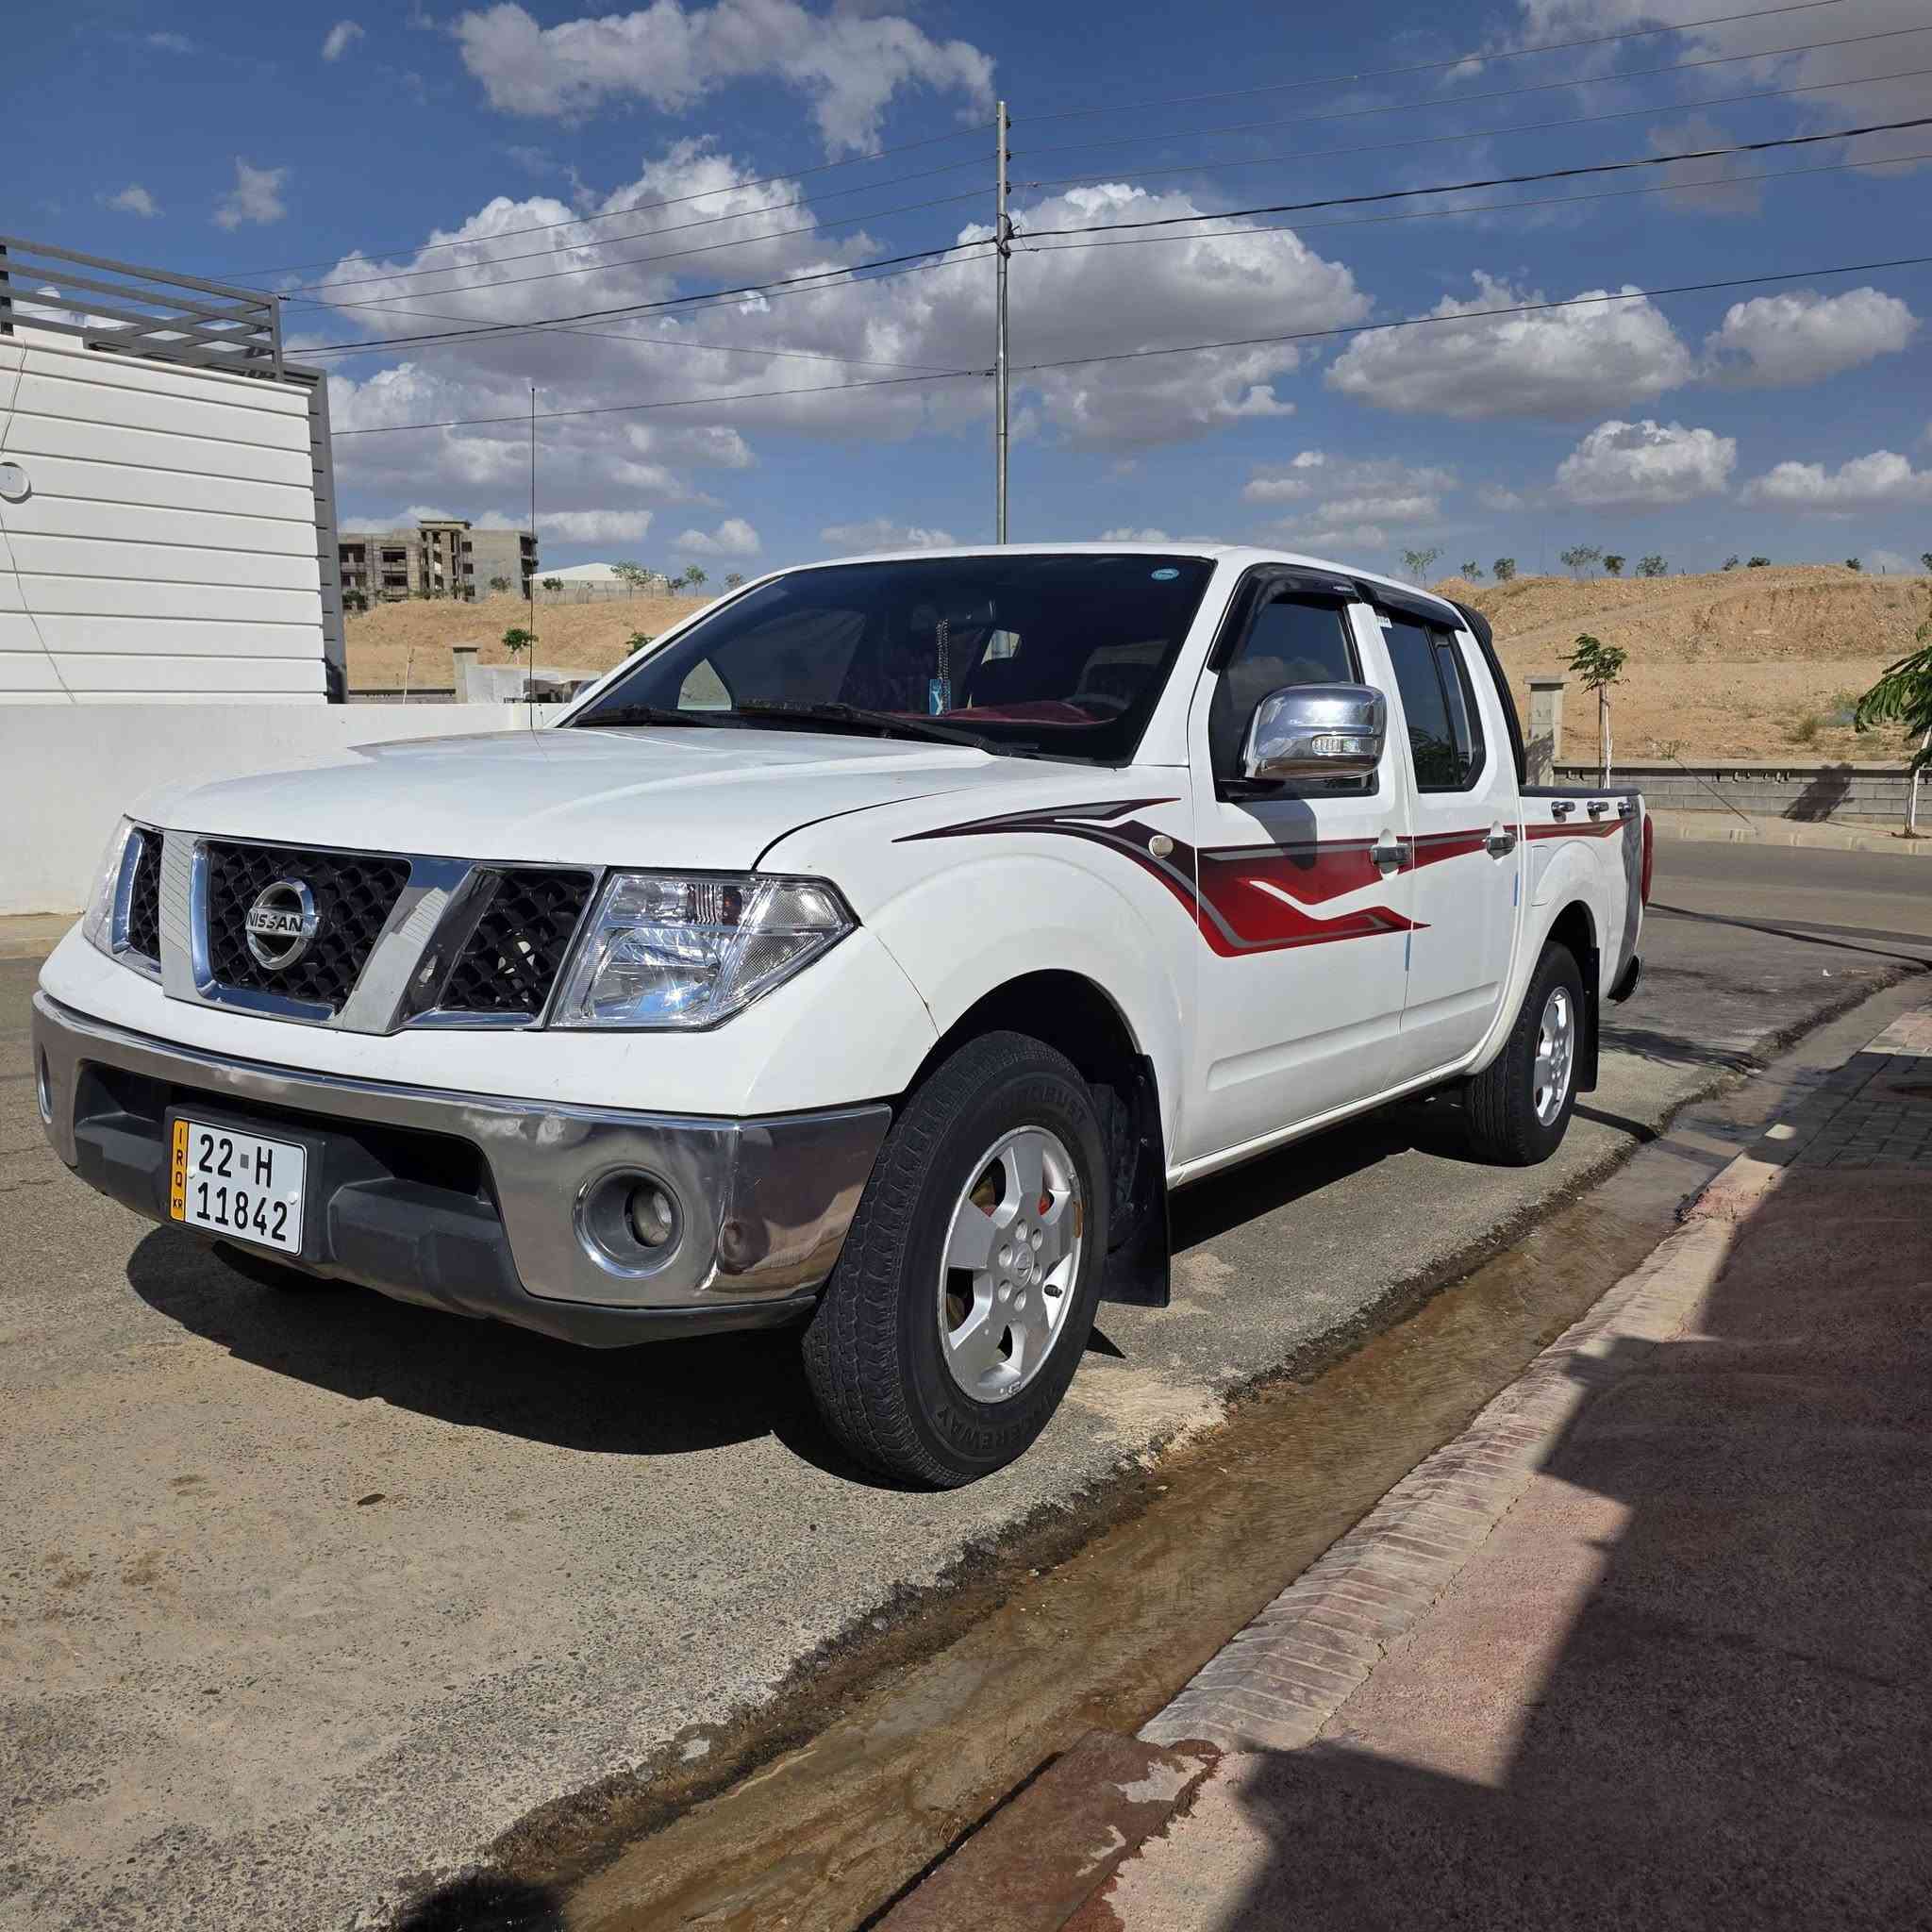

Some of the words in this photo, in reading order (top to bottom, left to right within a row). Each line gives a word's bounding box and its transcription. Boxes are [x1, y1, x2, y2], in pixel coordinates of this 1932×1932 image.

[247, 912, 303, 932] NISSAN
[175, 1128, 184, 1188] IRQ
[199, 1134, 233, 1178] 22
[255, 1146, 273, 1189] H
[196, 1182, 288, 1242] 11842
